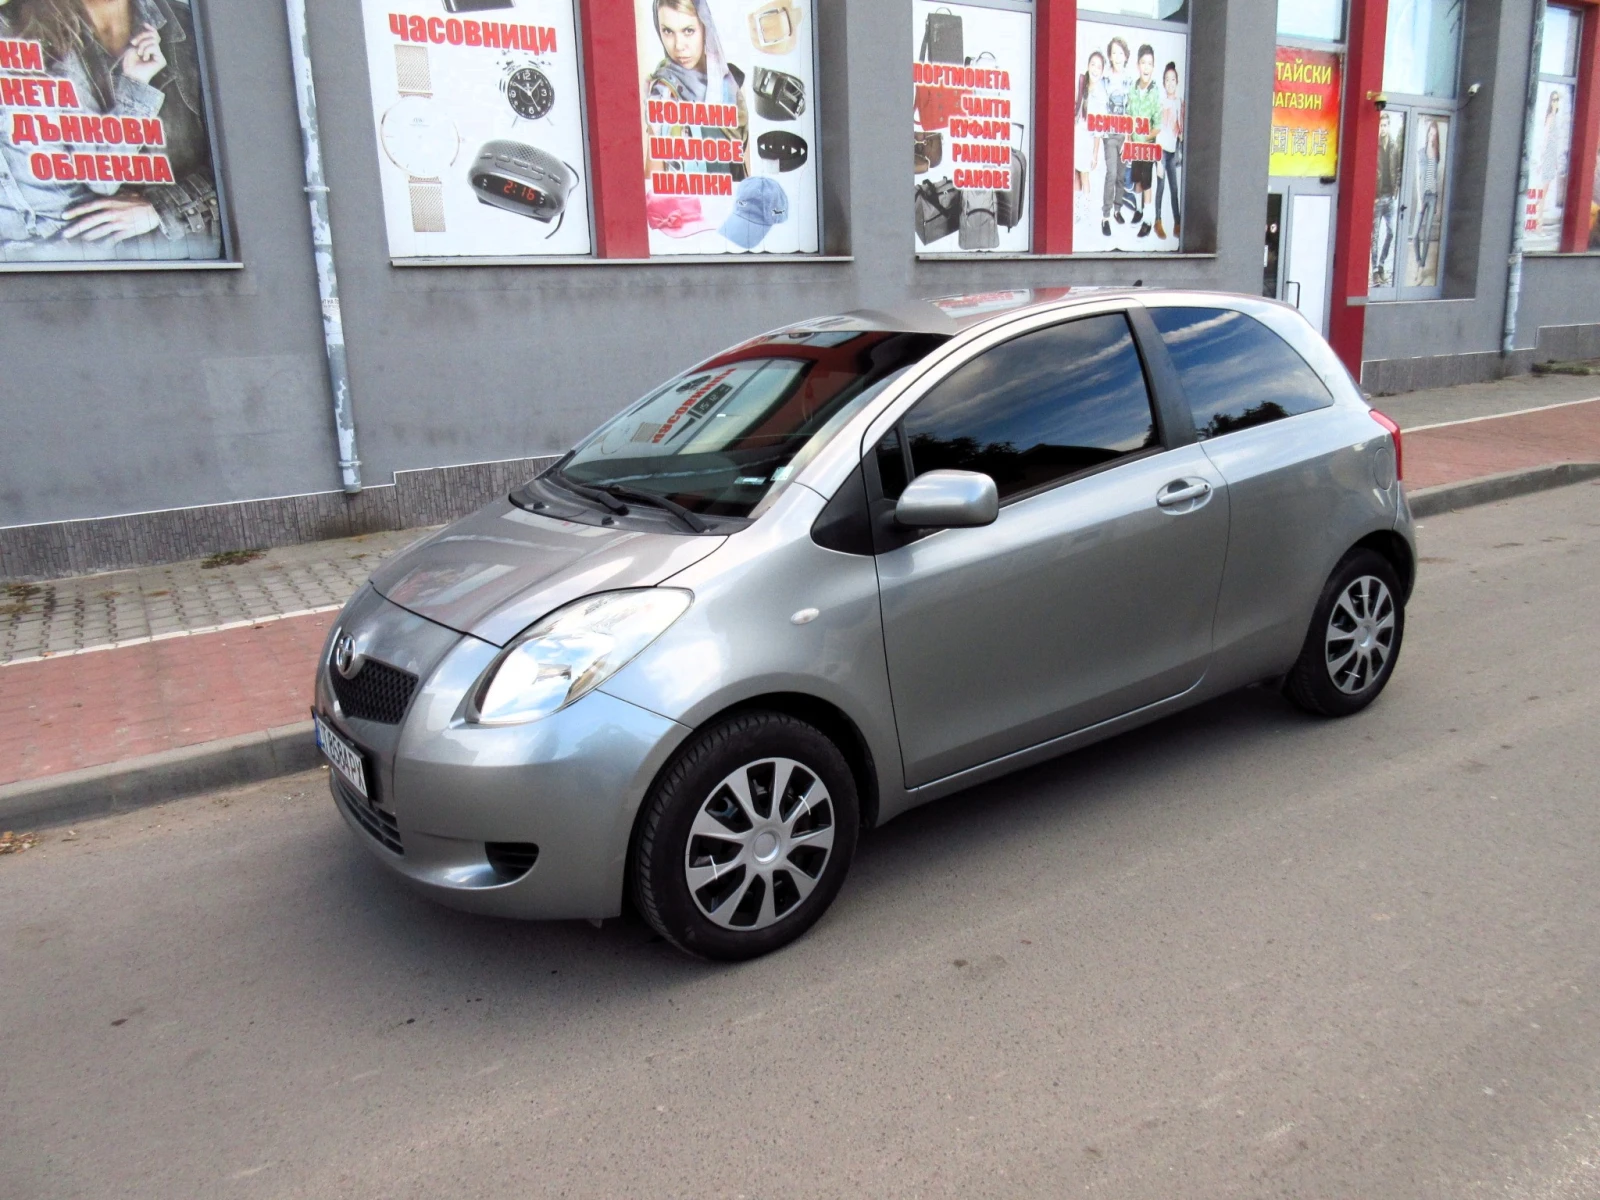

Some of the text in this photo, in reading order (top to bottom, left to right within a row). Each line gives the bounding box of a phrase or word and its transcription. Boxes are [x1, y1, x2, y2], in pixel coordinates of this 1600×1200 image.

[913, 62, 1010, 90] ПОРТМОНЕТА
[0, 78, 79, 108] КЕТА
[1272, 91, 1323, 110] АГАЗИН
[648, 100, 738, 127] КОЛАНИ
[962, 96, 1010, 118] ЧАНТИ
[11, 113, 163, 145] ДЪНКОВИ
[950, 118, 1010, 141] КУФАРИ
[1087, 113, 1150, 135] ВСИЧКО ЗА
[650, 137, 744, 162] ШАЛОВЕ
[952, 143, 1010, 166] РАНИЦИ
[1122, 142, 1162, 162] ДЕТЕТО
[30, 153, 175, 182] ОБЛЕКЛА
[953, 168, 1010, 189] САКОВЕ
[652, 173, 732, 195] ШАПКИ
